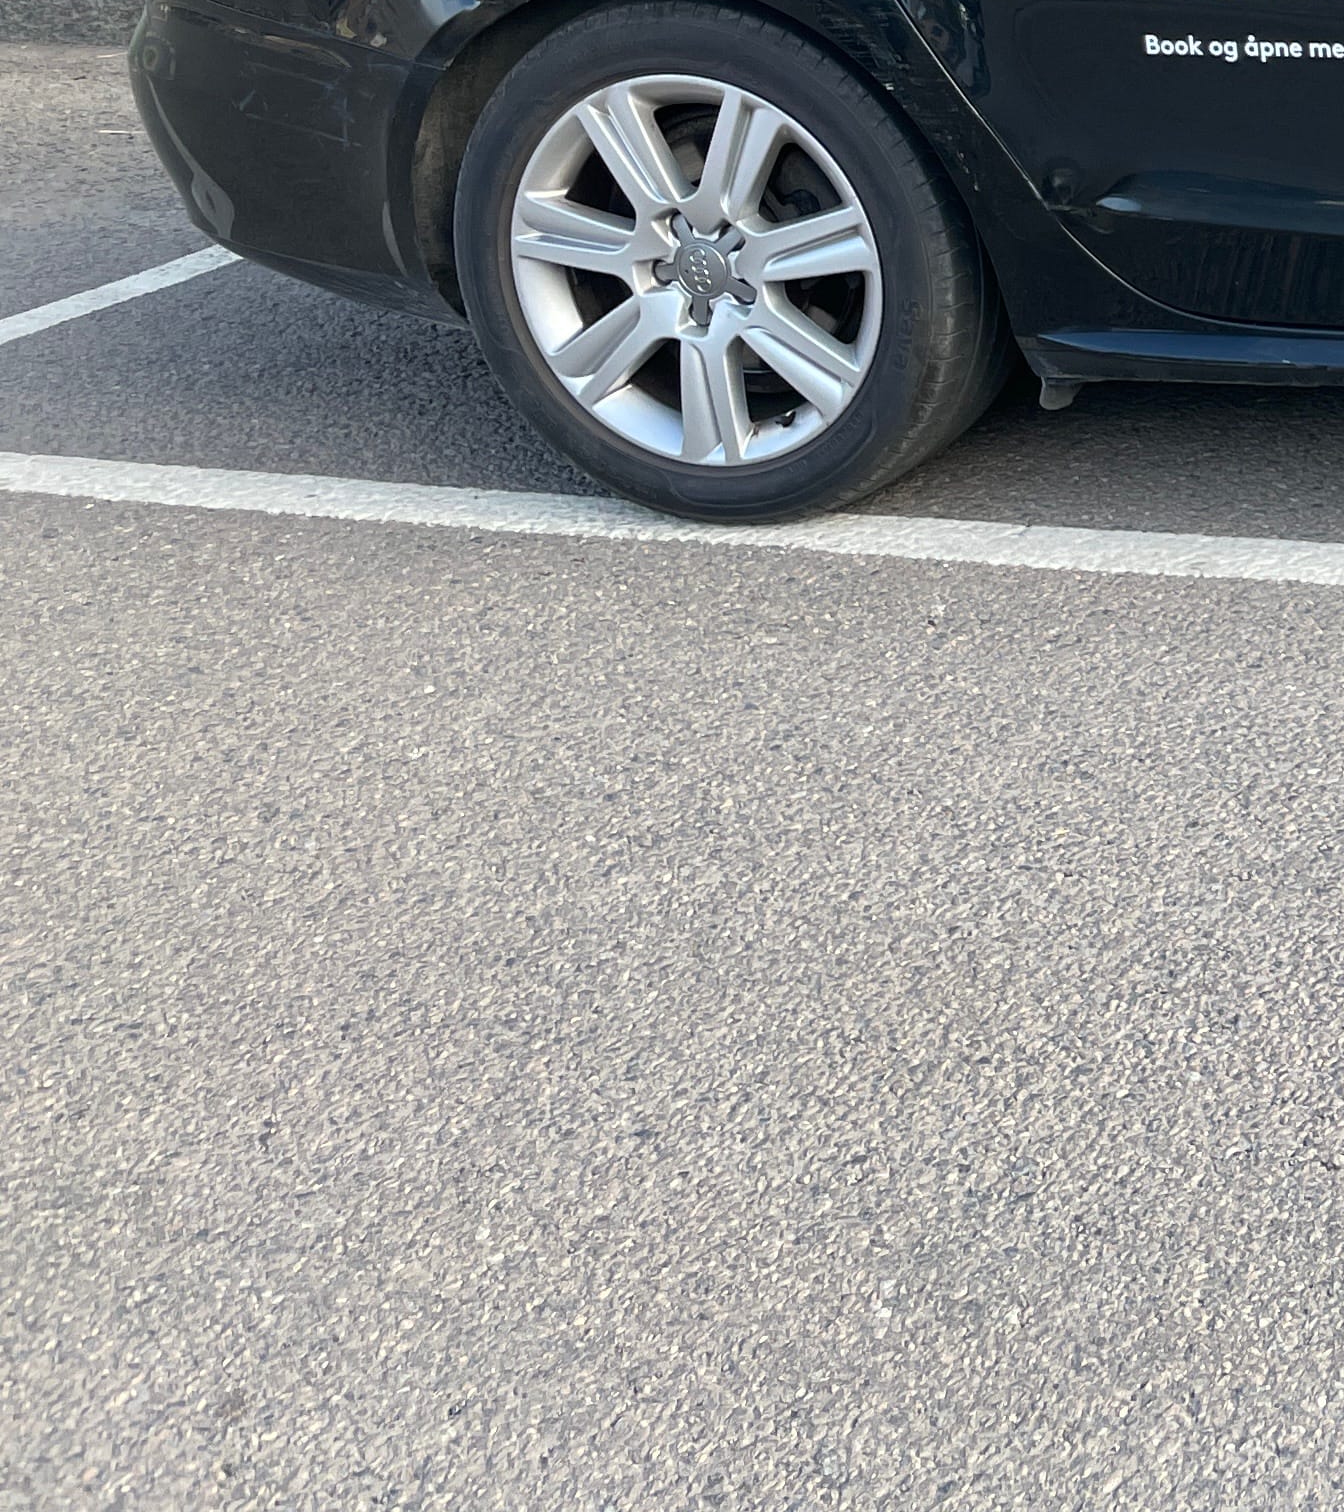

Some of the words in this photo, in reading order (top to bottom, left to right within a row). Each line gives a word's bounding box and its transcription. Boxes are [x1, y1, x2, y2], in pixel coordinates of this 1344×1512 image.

[1145, 35, 1203, 55] Book
[1209, 41, 1238, 62] og
[1244, 35, 1302, 62] åpne
